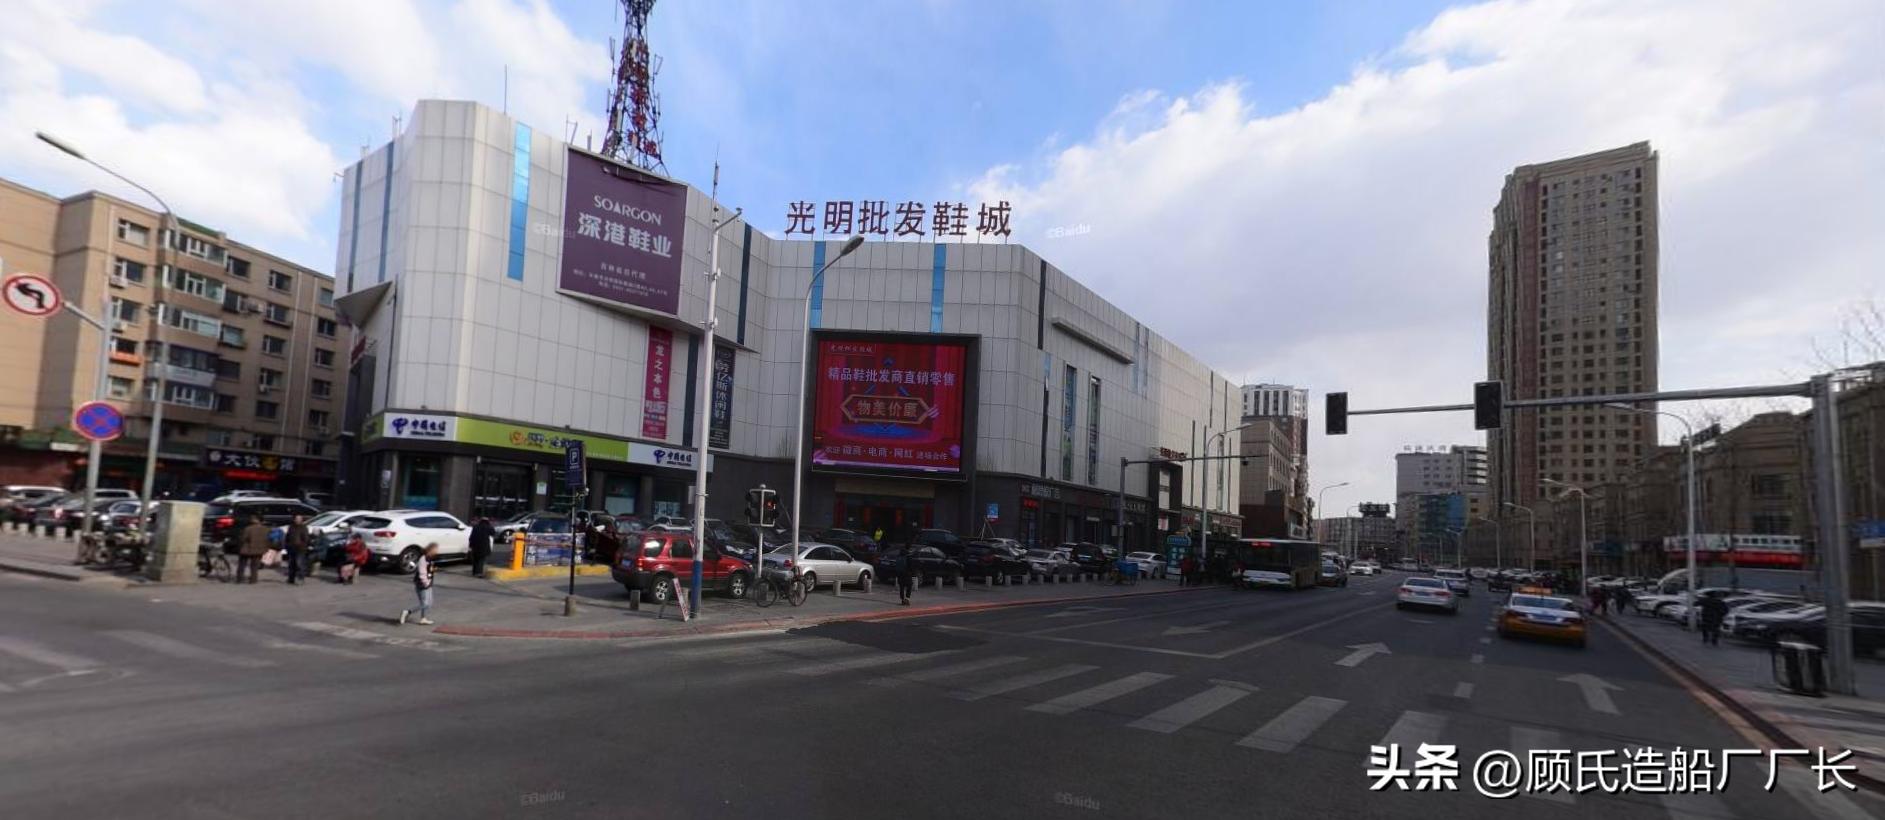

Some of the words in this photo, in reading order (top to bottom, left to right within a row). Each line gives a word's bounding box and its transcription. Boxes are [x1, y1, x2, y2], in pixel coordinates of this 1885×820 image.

[594, 195, 662, 226] SOARGON
[784, 200, 1012, 237] 光明批发鞋城
[577, 212, 673, 258] 深港鞋业
[828, 367, 956, 386] 精品鞋批发商直销零售
[857, 400, 919, 418] 物美价廉
